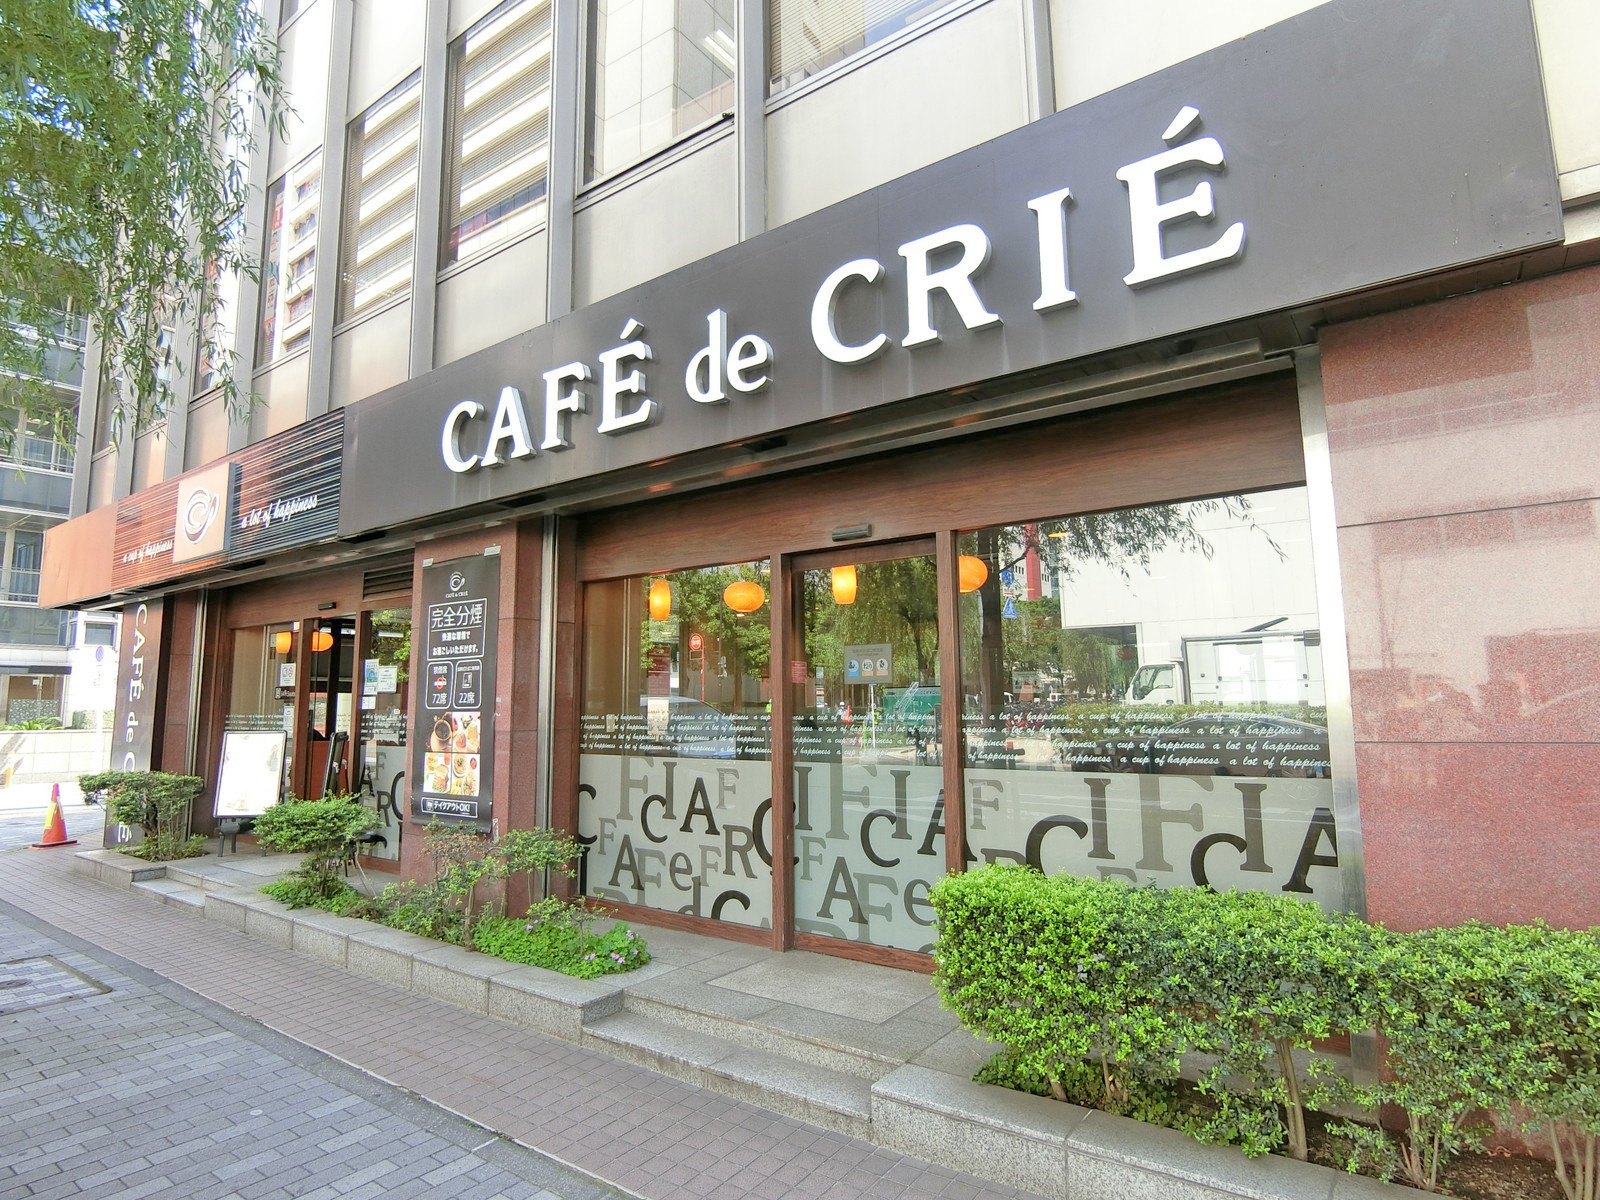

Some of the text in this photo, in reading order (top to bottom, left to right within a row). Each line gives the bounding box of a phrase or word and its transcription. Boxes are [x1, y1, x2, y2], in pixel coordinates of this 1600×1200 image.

[442, 106, 1247, 474] CAFÉ de CRIÉ
[241, 494, 318, 528] a lot of happiness
[145, 540, 173, 559] happiness
[431, 603, 483, 629] 完全分煙
[129, 603, 147, 702] CAFÉ
[432, 693, 447, 705] 72席
[459, 692, 475, 704] 22席
[670, 713, 695, 721] happiness
[714, 713, 720, 722] of
[722, 713, 749, 721] happiness
[999, 712, 1011, 720] lot
[1014, 712, 1024, 723] of
[1026, 711, 1070, 722] happiness
[1089, 714, 1106, 722] cup
[1111, 711, 1120, 722] of
[1124, 711, 1175, 721] happiness
[1193, 710, 1207, 719] lot
[126, 711, 139, 744] de
[677, 724, 703, 732] happiness
[721, 724, 728, 732] of
[729, 724, 756, 732] happiness
[826, 726, 838, 734] cup
[896, 724, 906, 732] lot
[1012, 725, 1024, 734] lot
[1026, 725, 1036, 736] of
[1039, 725, 1084, 736] happiness
[1103, 726, 1120, 736] cup
[1124, 725, 1136, 737] of
[1140, 724, 1191, 736] happiness
[1209, 725, 1225, 734] lot
[1229, 725, 1240, 737] of
[1246, 725, 1303, 737] happiness
[589, 733, 611, 741] happiness
[684, 734, 710, 742] happiness
[736, 734, 764, 743] happiness
[594, 742, 616, 750] happiness
[690, 744, 716, 752] happiness
[1052, 738, 1097, 749] happiness
[1116, 741, 1135, 750] cup
[1139, 740, 1150, 752] of
[1154, 739, 1206, 751] happiness
[1226, 740, 1241, 750] lot
[1245, 740, 1257, 753] of
[1262, 740, 1320, 753] happiness
[800, 746, 831, 756] happiness
[968, 751, 976, 762] of
[1066, 752, 1112, 764] happiness
[1132, 756, 1150, 765] cup
[1154, 755, 1166, 766] of
[1167, 754, 1220, 766] happiness
[1242, 756, 1258, 766] lot
[1262, 756, 1275, 769] of
[680, 777, 721, 836] A
[722, 824, 758, 880] R
[608, 834, 645, 891] A
[669, 852, 693, 892] e
[816, 855, 869, 925] A
